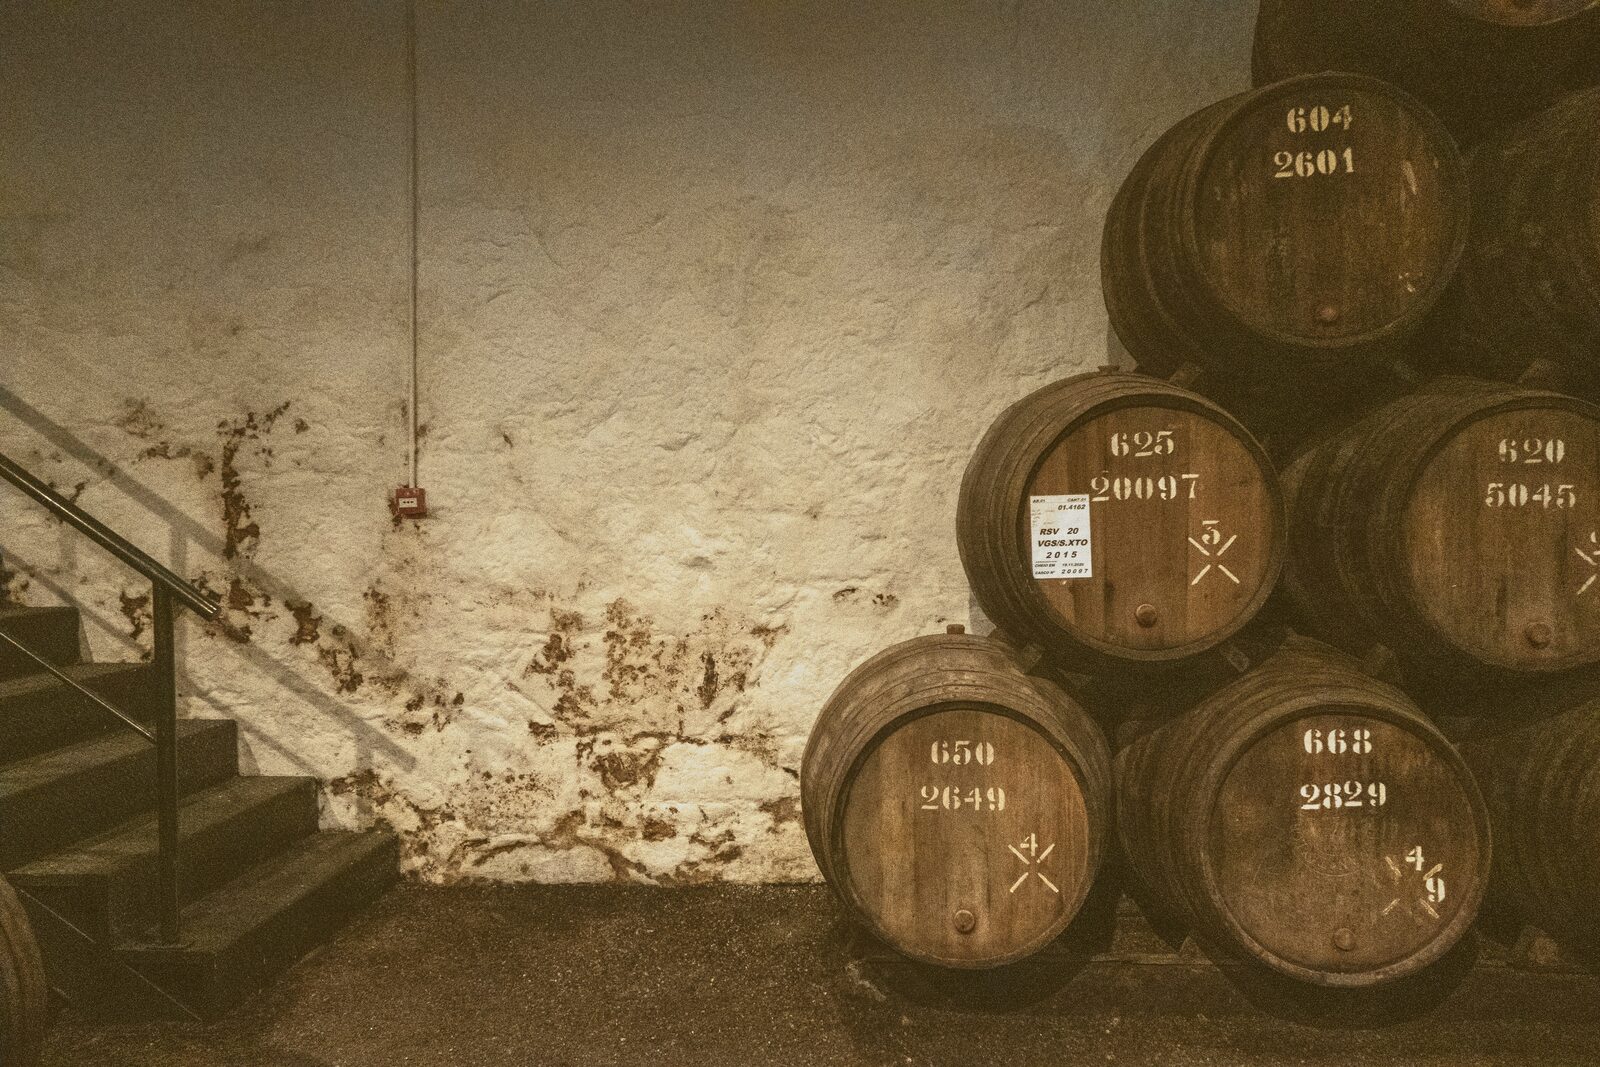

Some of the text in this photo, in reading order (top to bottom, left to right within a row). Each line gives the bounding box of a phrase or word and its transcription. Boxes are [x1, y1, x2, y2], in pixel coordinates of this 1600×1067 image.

[1286, 104, 1353, 133] 604
[1274, 146, 1354, 178] 2601
[1110, 430, 1175, 458] 625
[1498, 438, 1565, 464] 620
[1090, 473, 1200, 502] 20097
[1485, 482, 1576, 508] 5045
[1038, 539, 1088, 547] VGS/S.XTO
[930, 740, 994, 766] 650
[1304, 728, 1372, 754] 668
[920, 785, 1006, 811] 2649
[1300, 780, 1387, 810] 2829
[1020, 832, 1038, 857] 4
[1404, 845, 1425, 871] 4
[1425, 877, 1446, 903] 9
